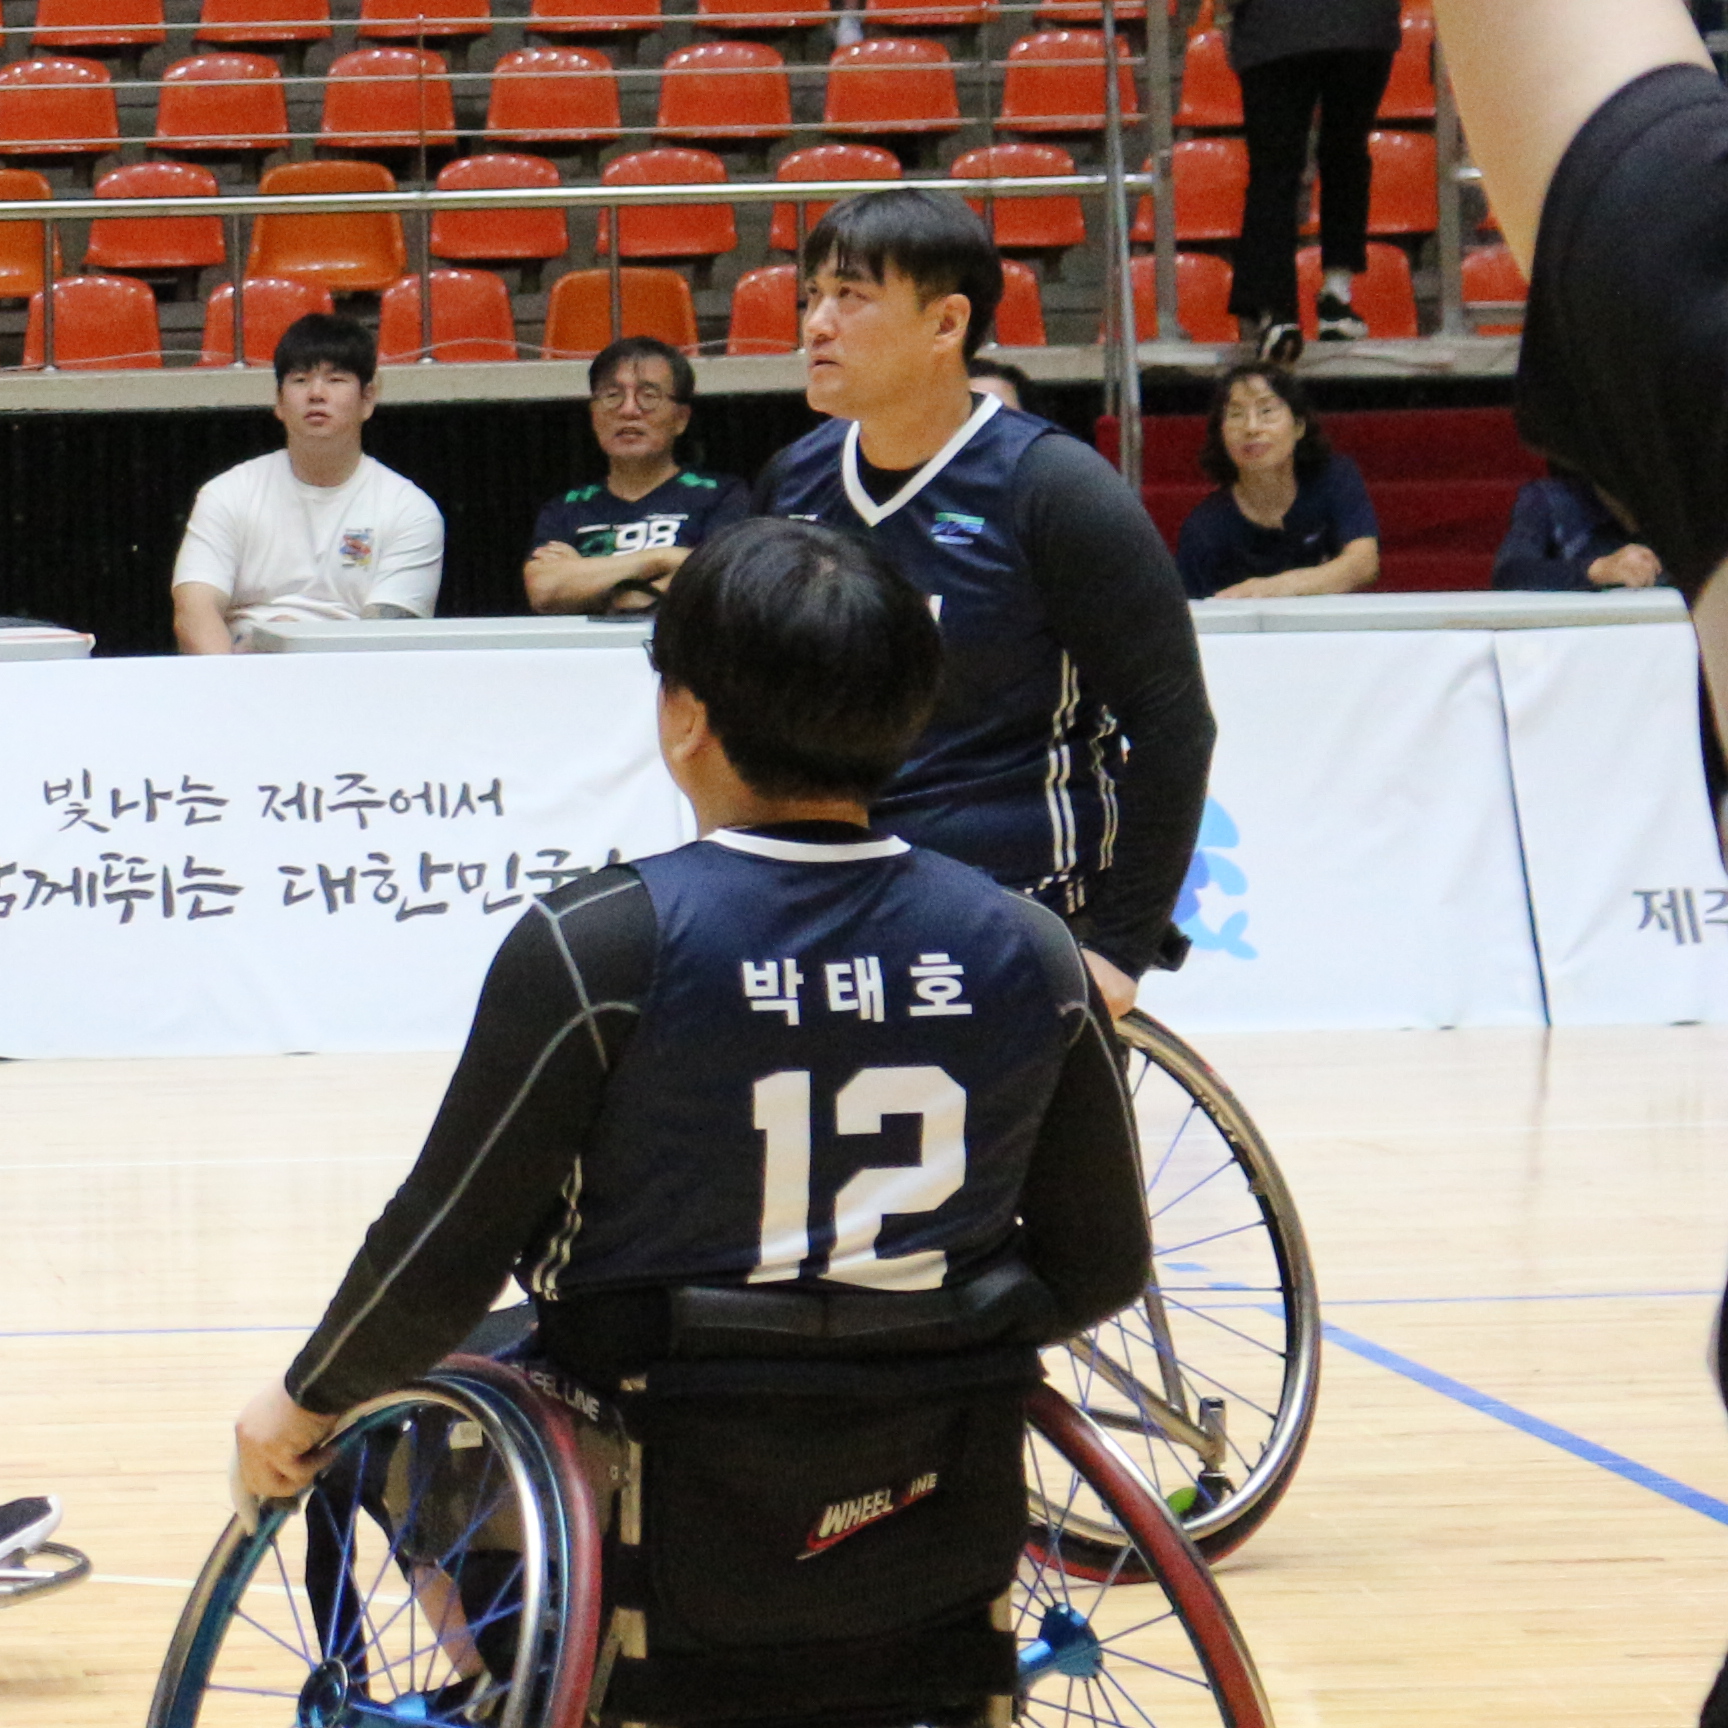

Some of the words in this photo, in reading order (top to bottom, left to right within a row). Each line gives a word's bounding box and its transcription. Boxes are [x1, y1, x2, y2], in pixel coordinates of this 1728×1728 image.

[613, 520, 682, 557] 98
[43, 769, 231, 834] 빛나는
[258, 773, 504, 829] 제주에서
[277, 848, 621, 922] 대한민국
[742, 952, 973, 1027] 박태호
[749, 1065, 968, 1291] 12
[818, 1487, 894, 1539] WHEEL
